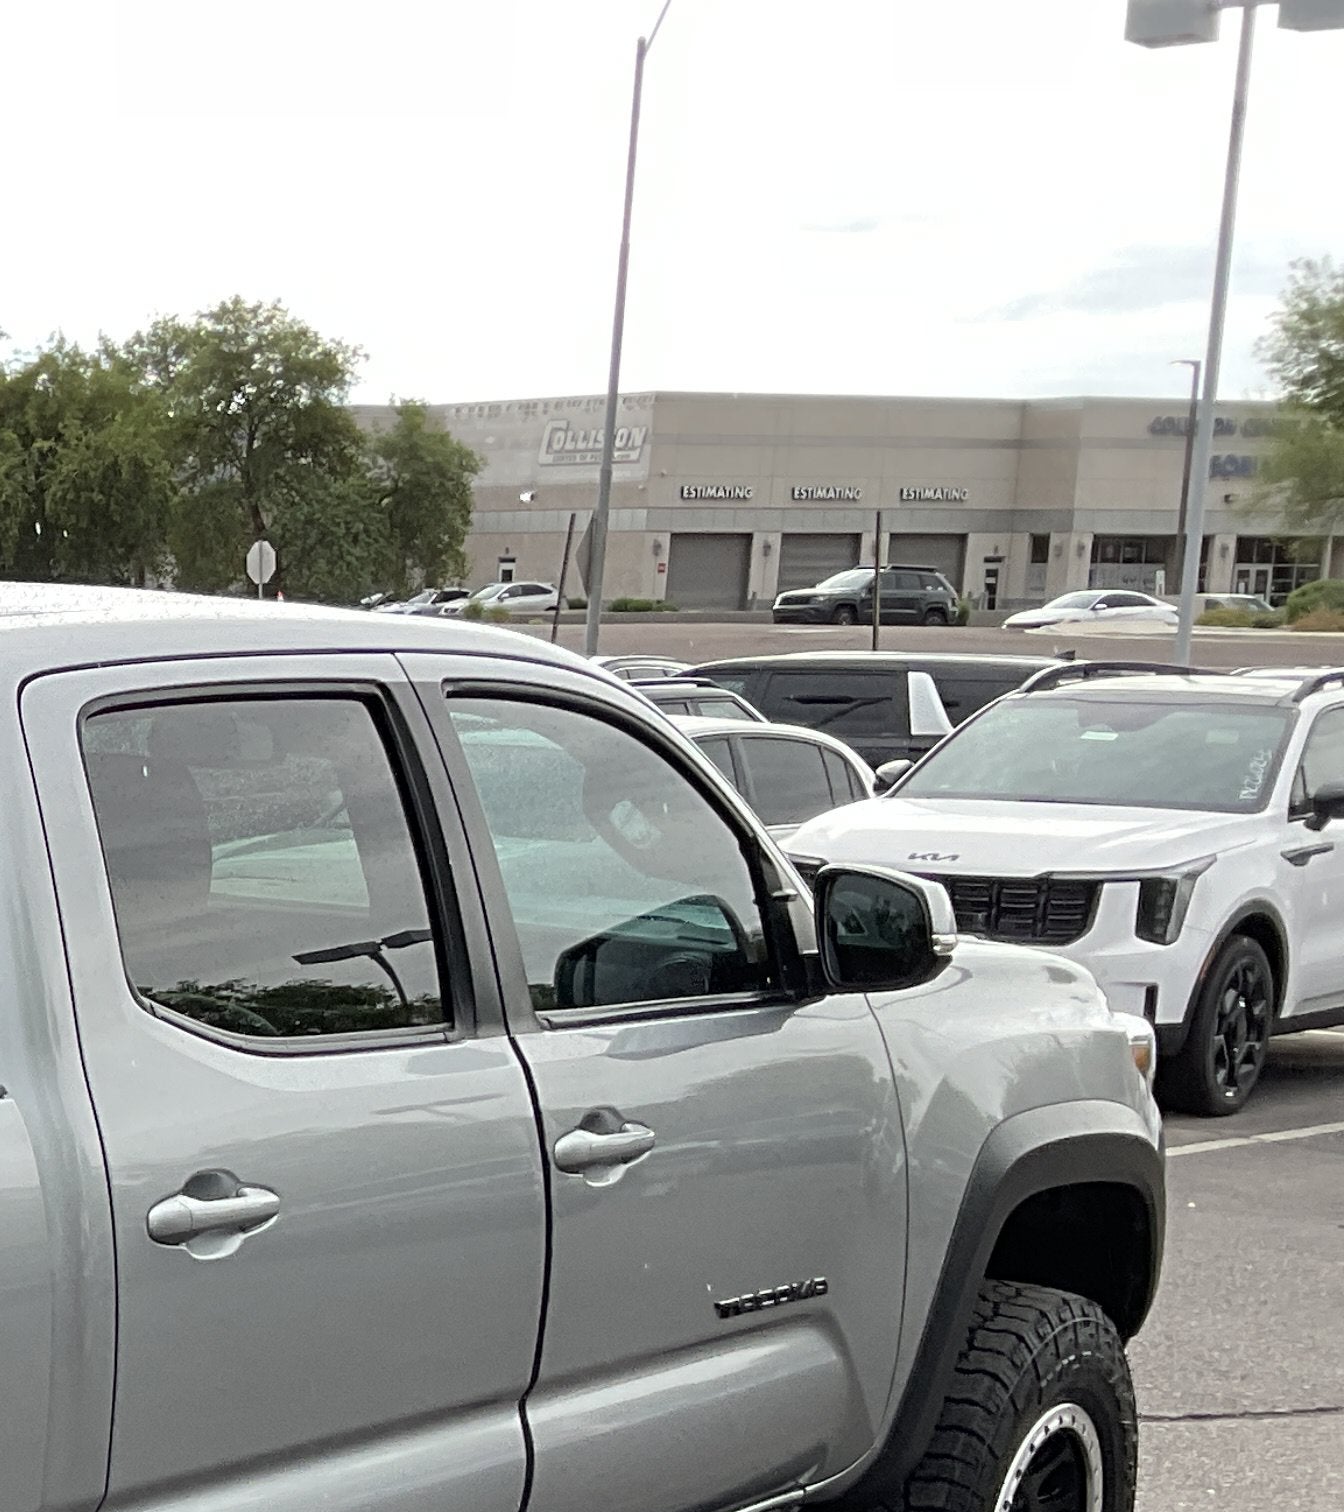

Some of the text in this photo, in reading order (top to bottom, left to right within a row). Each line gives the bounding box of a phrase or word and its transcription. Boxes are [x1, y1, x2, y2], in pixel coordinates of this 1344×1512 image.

[539, 418, 649, 466] COLLISON
[681, 485, 753, 500] ESTIMATING
[792, 486, 863, 501] ESTIMATING
[900, 487, 969, 501] ESTIMATING
